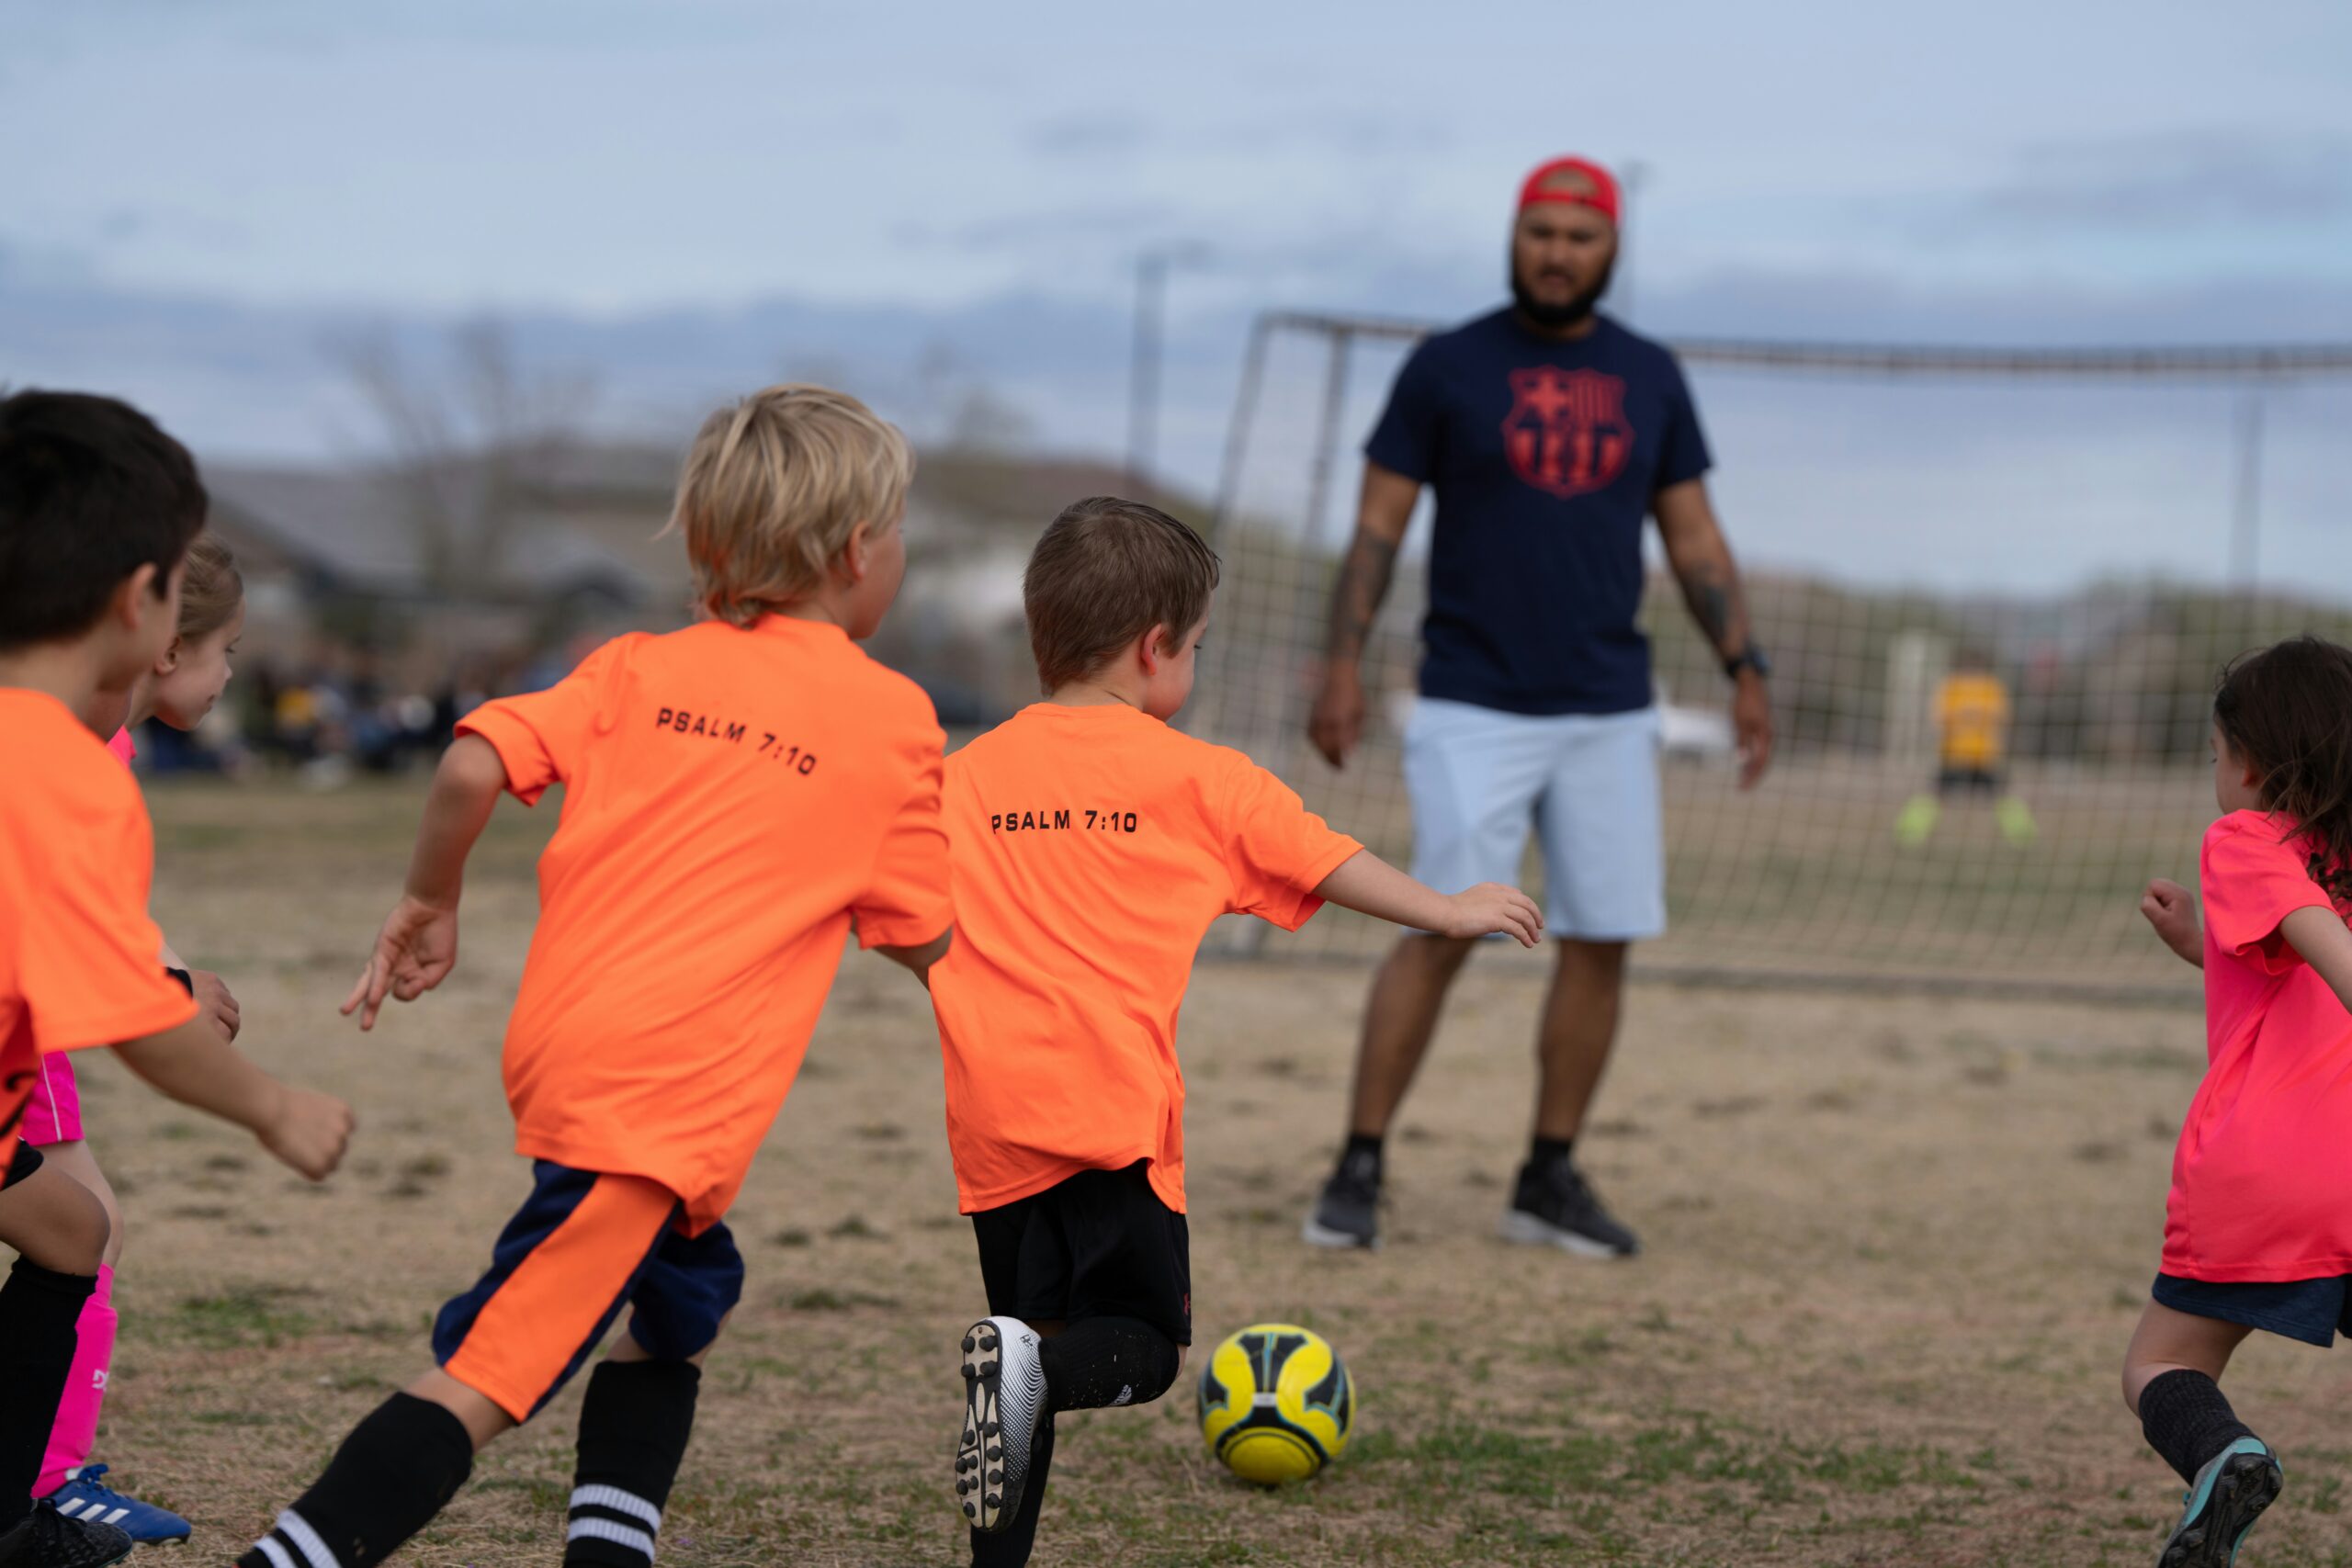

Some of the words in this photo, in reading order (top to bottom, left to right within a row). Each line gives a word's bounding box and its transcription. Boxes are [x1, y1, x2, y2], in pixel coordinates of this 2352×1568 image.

[656, 707, 746, 743] PSALM
[758, 732, 817, 775] 7:10
[991, 809, 1070, 835] PSALM
[1085, 810, 1137, 833] 7:10
